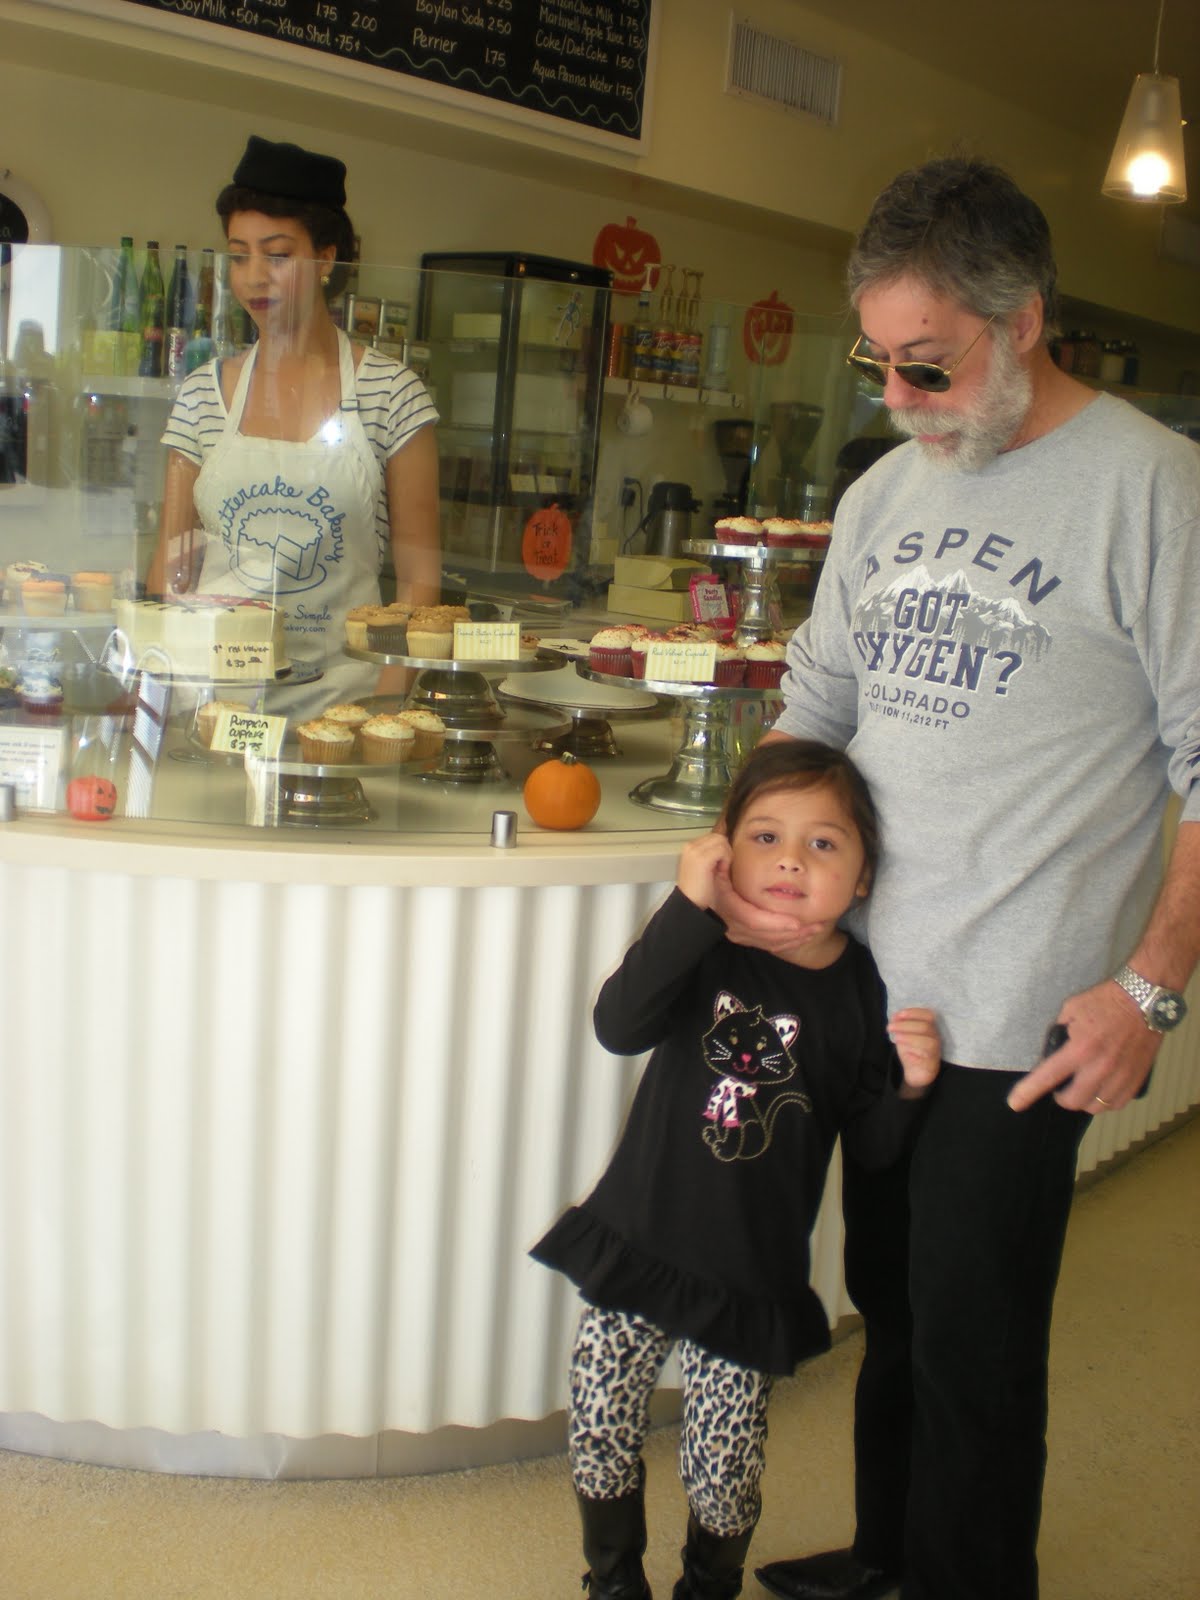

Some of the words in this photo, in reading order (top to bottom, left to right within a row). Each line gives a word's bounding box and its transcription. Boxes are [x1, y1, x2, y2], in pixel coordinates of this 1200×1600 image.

[416, 0, 458, 24] Boylan
[461, 6, 484, 28] Soda
[595, 4, 613, 22] Milk
[306, 23, 331, 47] Shot
[412, 27, 458, 54] Perrier
[532, 59, 556, 84] Aqua
[557, 65, 587, 87] Panna
[589, 74, 613, 93] Water
[217, 475, 303, 553] uttercake
[306, 485, 346, 563] Bakery
[532, 521, 559, 537] Trick
[533, 547, 560, 566] Treat
[294, 604, 333, 622] Simple
[893, 588, 970, 636] GOT
[901, 711, 932, 727] 11,212
[934, 719, 950, 730] FT
